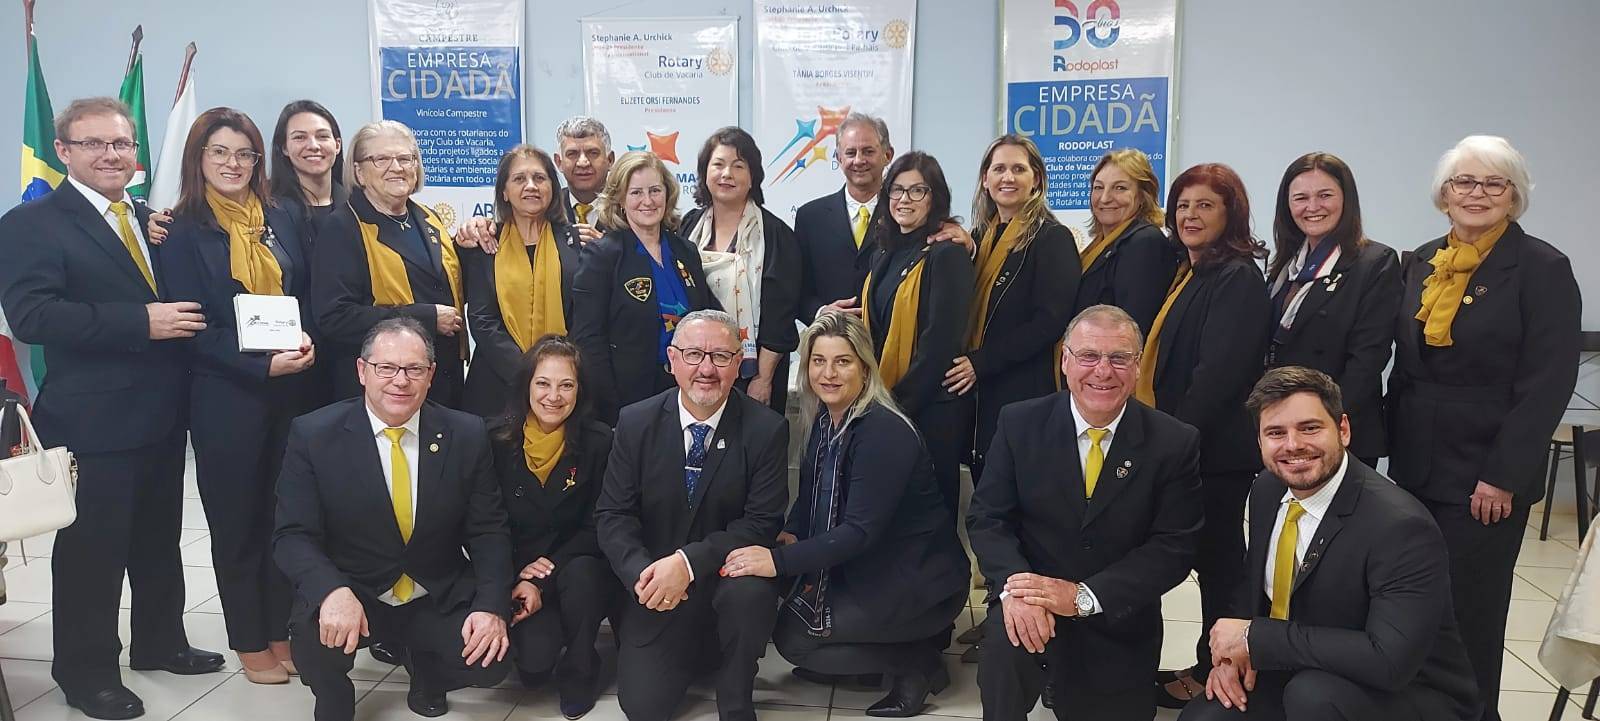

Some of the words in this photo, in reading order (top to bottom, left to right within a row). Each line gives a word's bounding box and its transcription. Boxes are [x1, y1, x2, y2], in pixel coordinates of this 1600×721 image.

[418, 33, 479, 43] CAMPESTRE
[591, 33, 631, 43] Stephanie
[633, 33, 642, 41] A.
[644, 33, 673, 41] Urchick
[408, 52, 492, 68] EMPRESA
[658, 55, 703, 70] Rotary
[1053, 55, 1119, 73] Rodoplast
[644, 71, 662, 79] Club
[664, 71, 674, 79] de
[676, 71, 703, 79] Vacaria
[387, 63, 517, 100] CIDADÃ
[1039, 83, 1136, 103] EMPRESA
[620, 96, 644, 105] ELIZETE
[645, 96, 661, 105] ORSI
[662, 96, 701, 105] FERNANDES
[416, 108, 445, 118] Vinícola
[446, 108, 488, 119] Campestre
[1013, 92, 1161, 136] CIDADÃ
[411, 128, 429, 136] bora
[430, 129, 447, 137] com
[459, 129, 497, 137] rotarianos
[498, 129, 509, 137] do
[416, 139, 435, 147] otary
[436, 138, 453, 146] Club
[455, 138, 464, 146] de
[1058, 140, 1115, 151] RODOPLAST
[439, 147, 469, 157] projetos
[471, 147, 498, 157] ligados
[1153, 152, 1163, 160] do
[456, 156, 476, 164] áreas
[1058, 154, 1087, 162] colabora
[1046, 163, 1063, 171] Club
[1065, 163, 1075, 171] de
[425, 174, 450, 183] Rotária
[466, 175, 484, 183] todo
